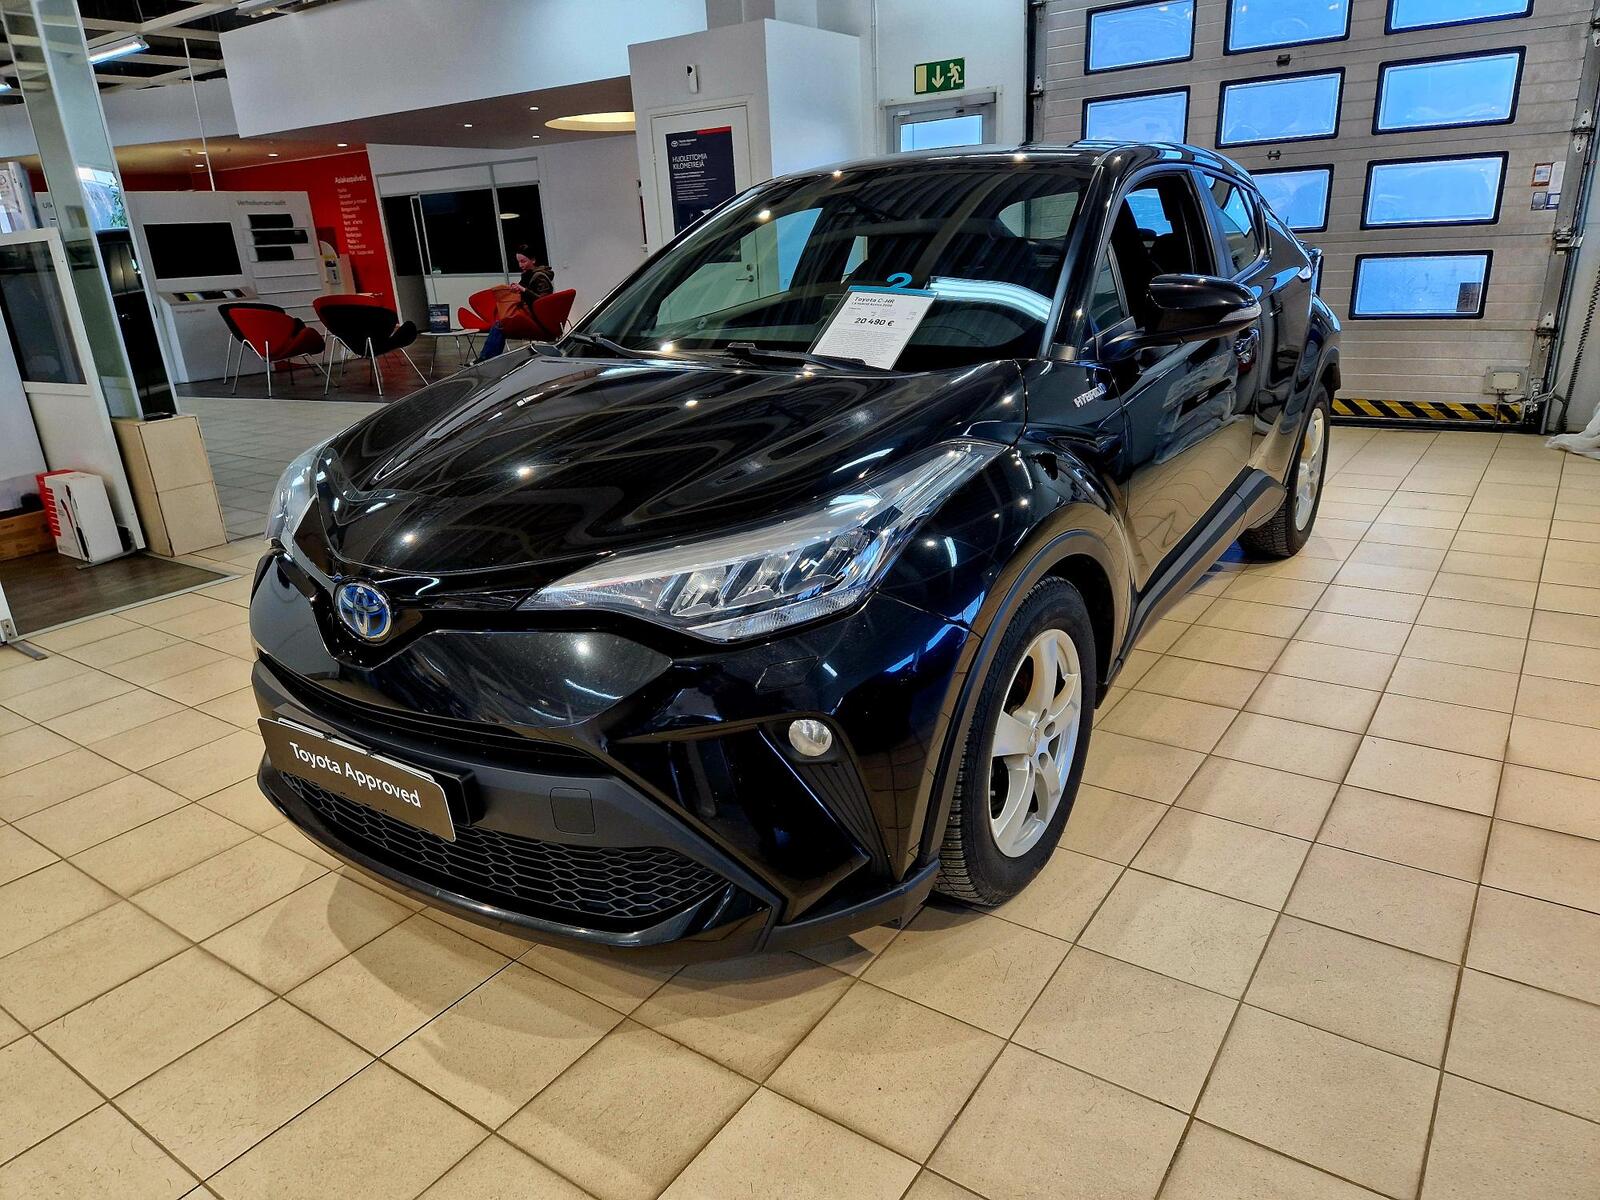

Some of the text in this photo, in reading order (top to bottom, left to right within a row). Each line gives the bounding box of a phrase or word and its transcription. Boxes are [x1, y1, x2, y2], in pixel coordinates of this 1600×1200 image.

[672, 153, 707, 162] HUOLETTOMIA
[672, 160, 704, 169] KILOMETREJÄ
[878, 297, 896, 305] C-HR
[854, 317, 867, 325] 20
[867, 318, 887, 327] 490
[1073, 384, 1105, 408] HYBRID
[289, 741, 422, 808] Toyota Approved
